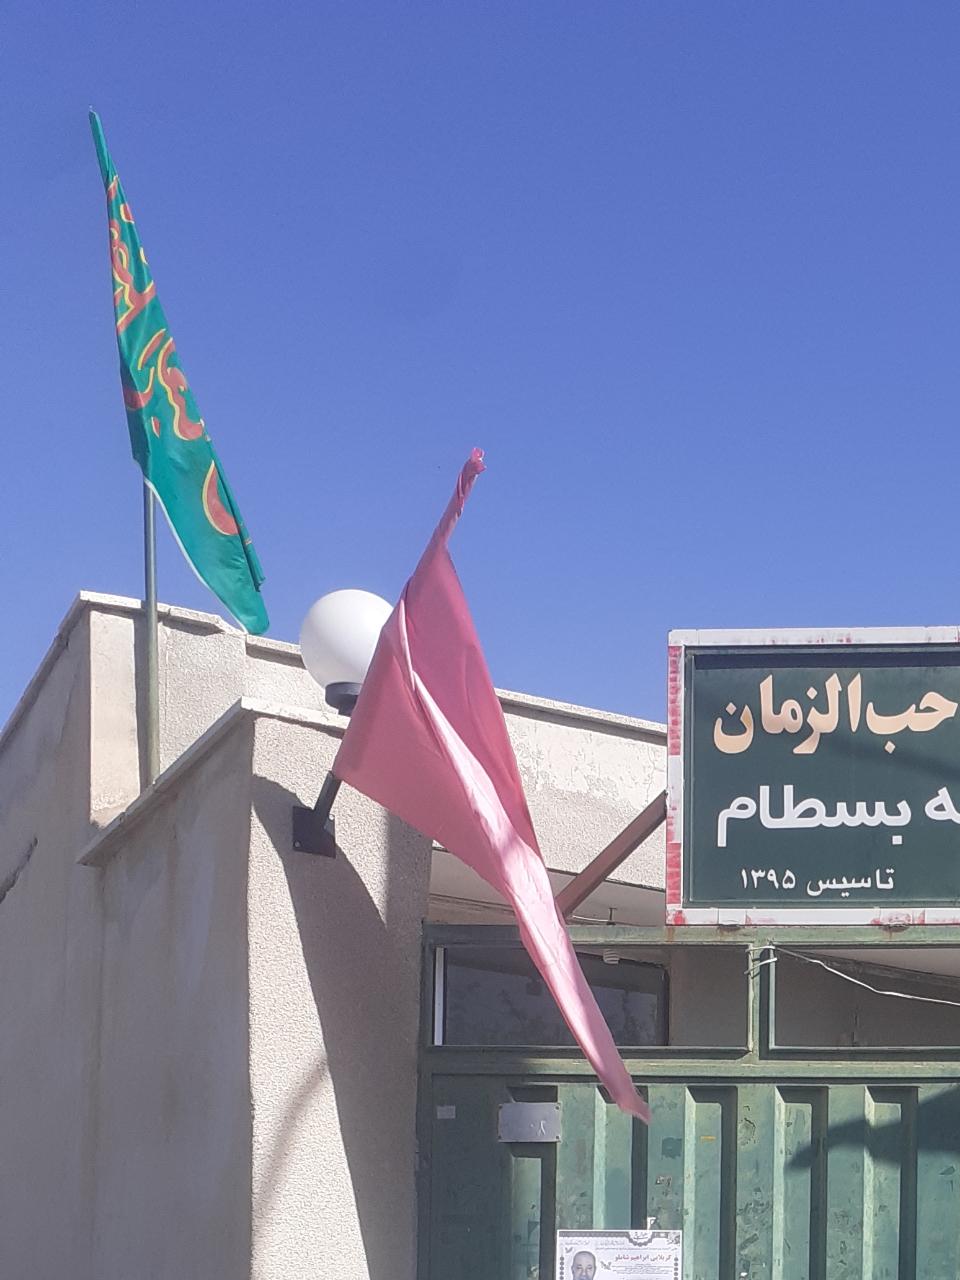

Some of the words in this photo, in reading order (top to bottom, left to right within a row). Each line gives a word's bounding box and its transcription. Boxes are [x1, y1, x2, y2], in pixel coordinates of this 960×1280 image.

[713, 672, 862, 755] الزمان
[717, 784, 912, 848] بسطام
[741, 868, 796, 889] ۱۳۹۵
[806, 868, 895, 898] تاسیس
